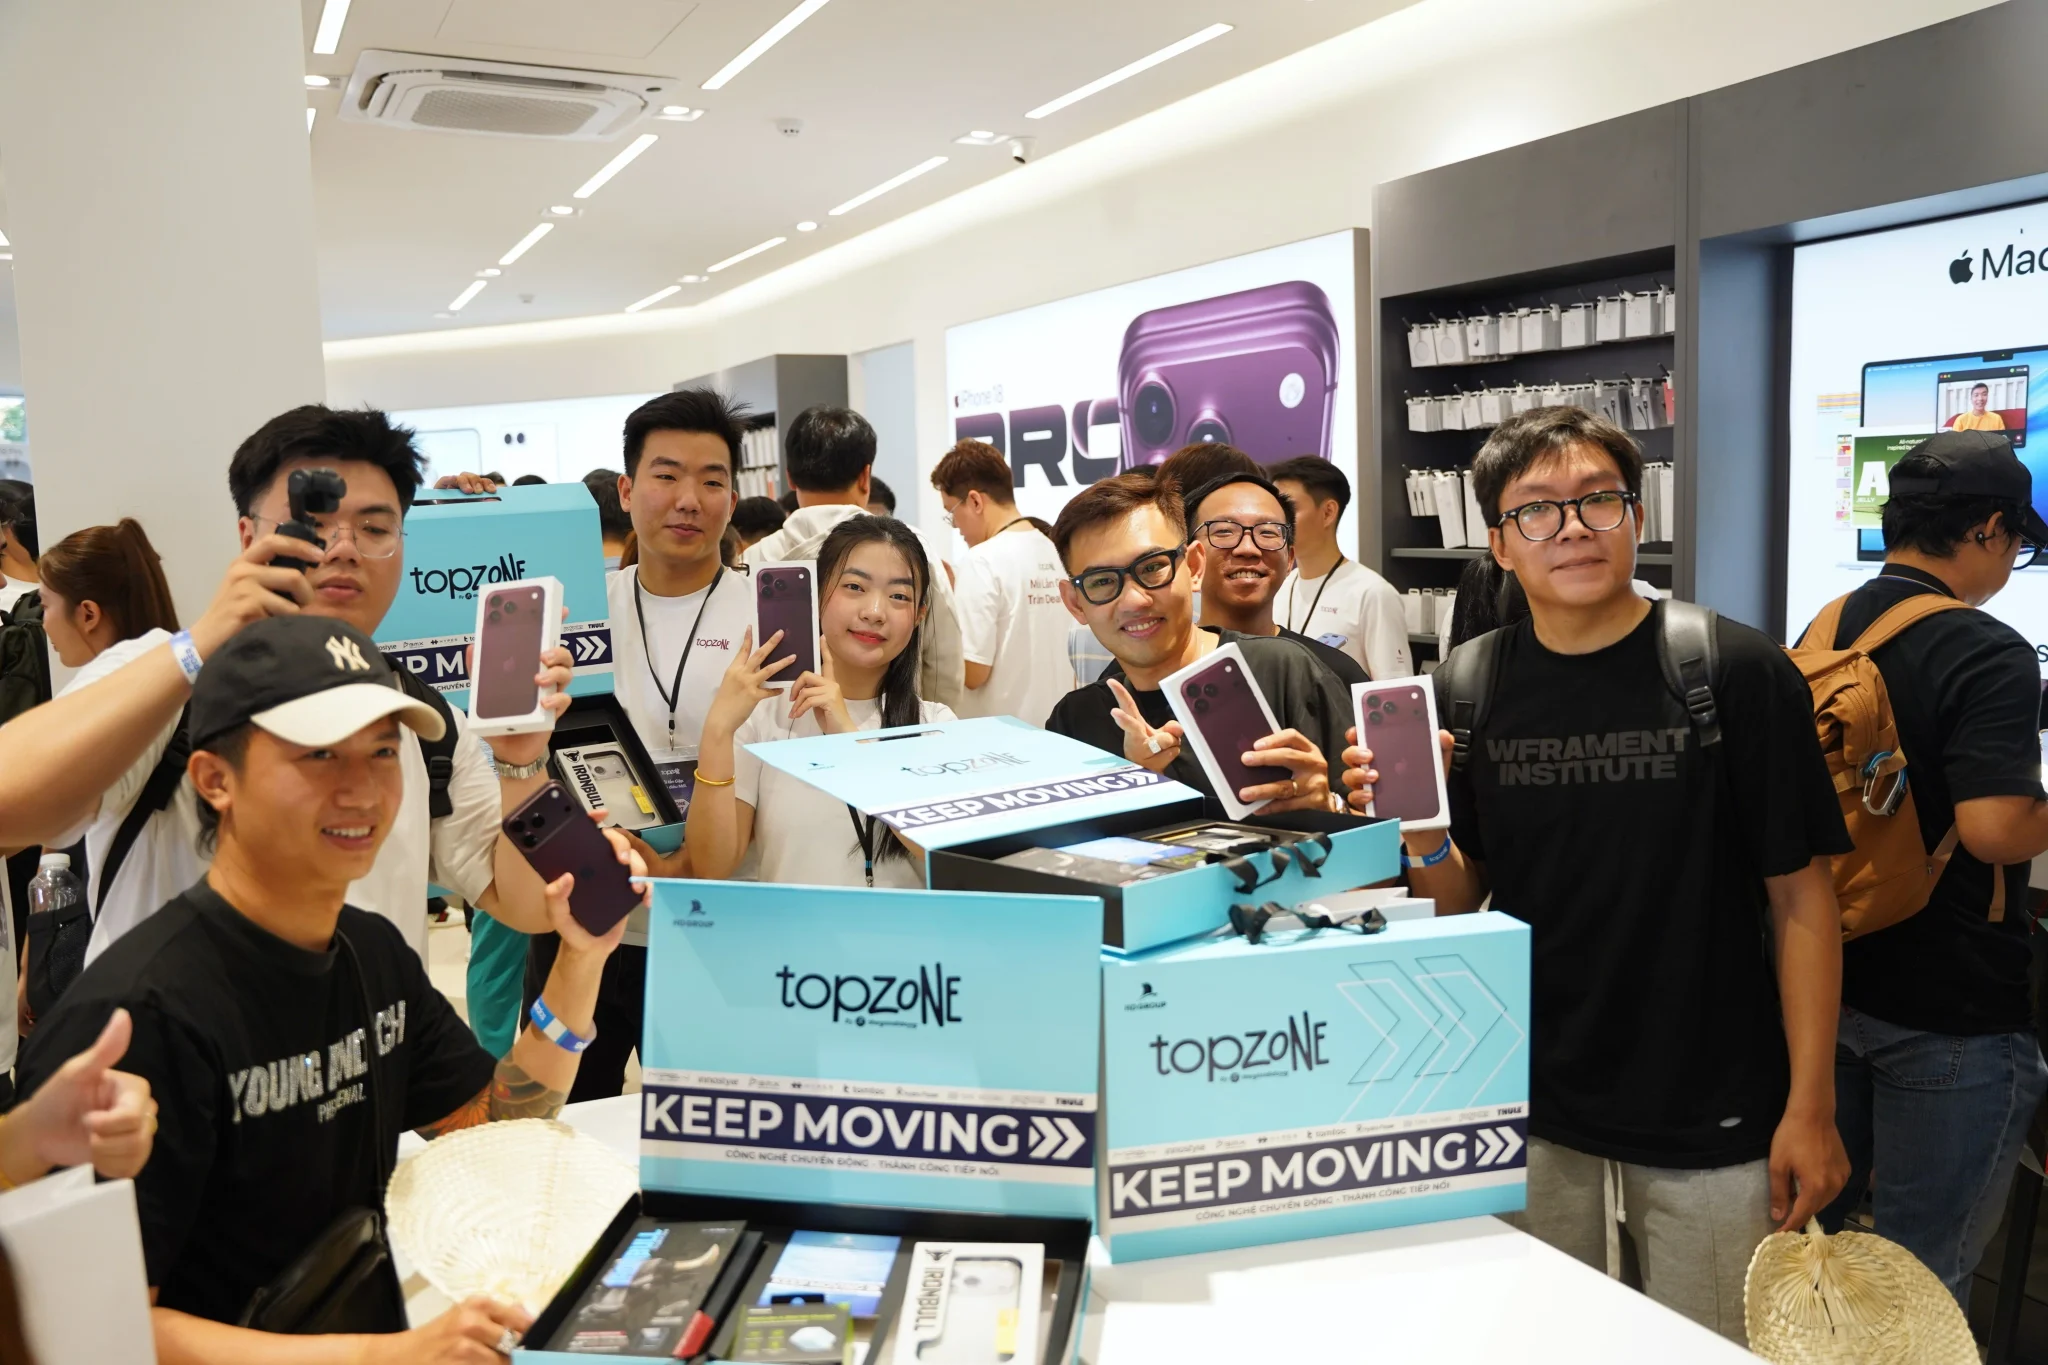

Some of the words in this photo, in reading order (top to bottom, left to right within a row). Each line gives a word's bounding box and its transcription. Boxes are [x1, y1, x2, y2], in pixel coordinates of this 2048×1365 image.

[571, 763, 605, 810] IRONBULL
[881, 798, 986, 828] KEEP
[988, 774, 1126, 811] MOVING
[228, 1049, 325, 1124] YOUNG
[1496, 1105, 1523, 1116] THULE
[644, 1092, 784, 1140] KEEP
[793, 1102, 1021, 1157] MOVING
[725, 1147, 755, 1160] CÔNG
[1112, 1158, 1252, 1211] KEEP
[1261, 1132, 1468, 1194] MOVING
[1195, 1209, 1225, 1221] CÔNG
[914, 1267, 945, 1331] IRONBULL
